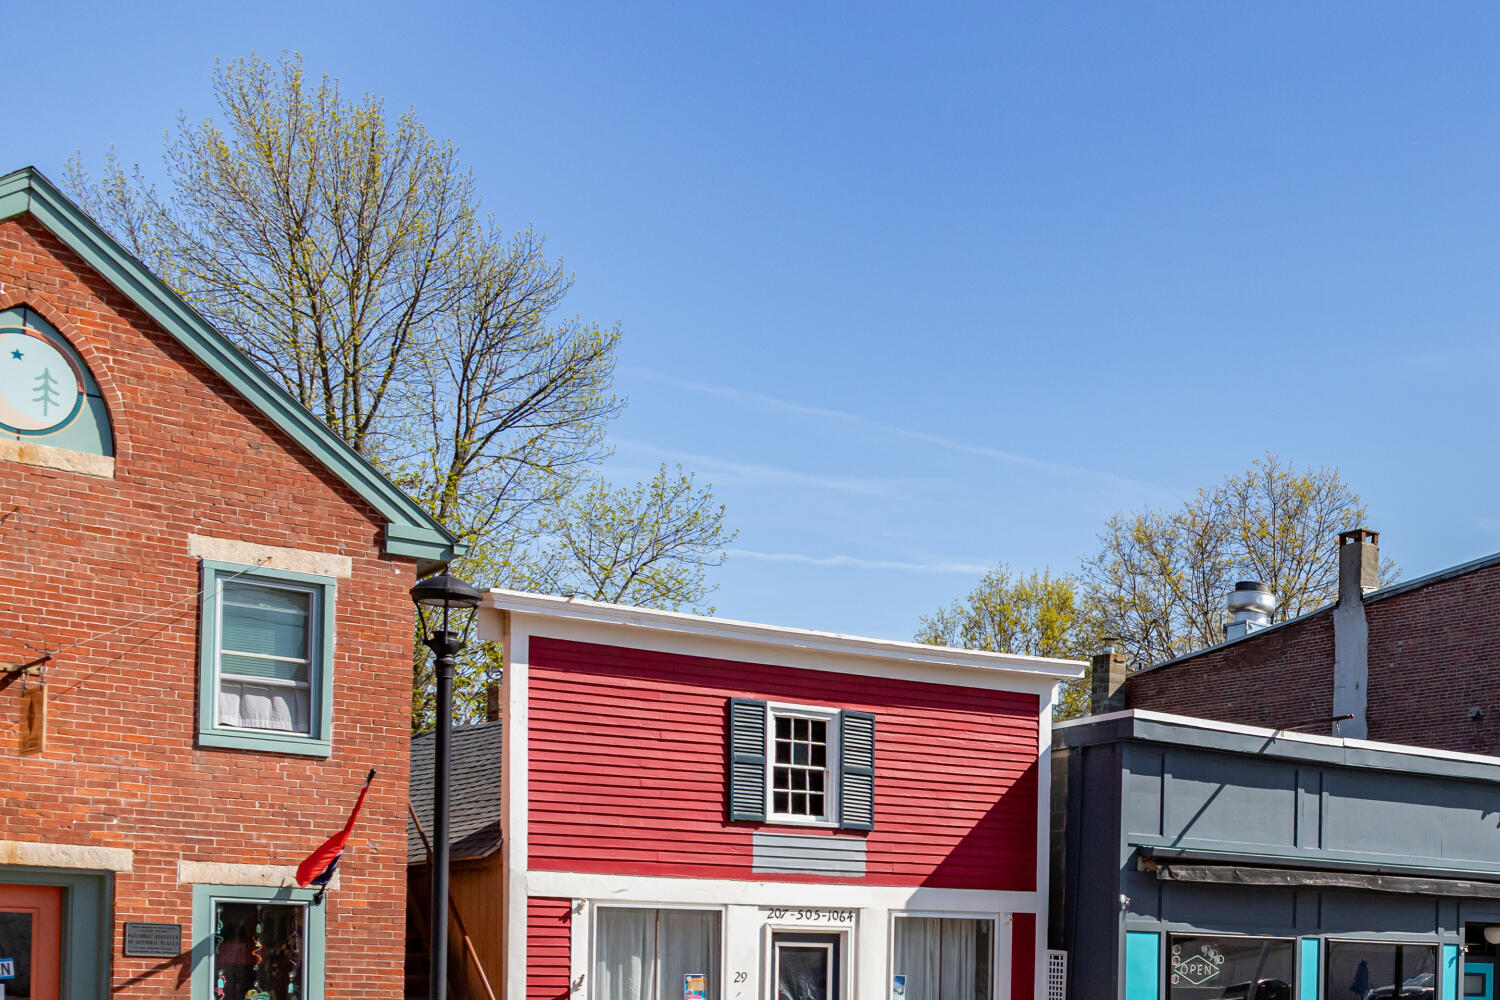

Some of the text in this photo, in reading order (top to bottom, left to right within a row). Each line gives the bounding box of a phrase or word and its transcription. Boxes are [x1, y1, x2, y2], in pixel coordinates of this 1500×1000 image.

[767, 907, 854, 923] 207-505-1064
[1180, 963, 1212, 976] OPEN
[733, 971, 748, 984] 29
